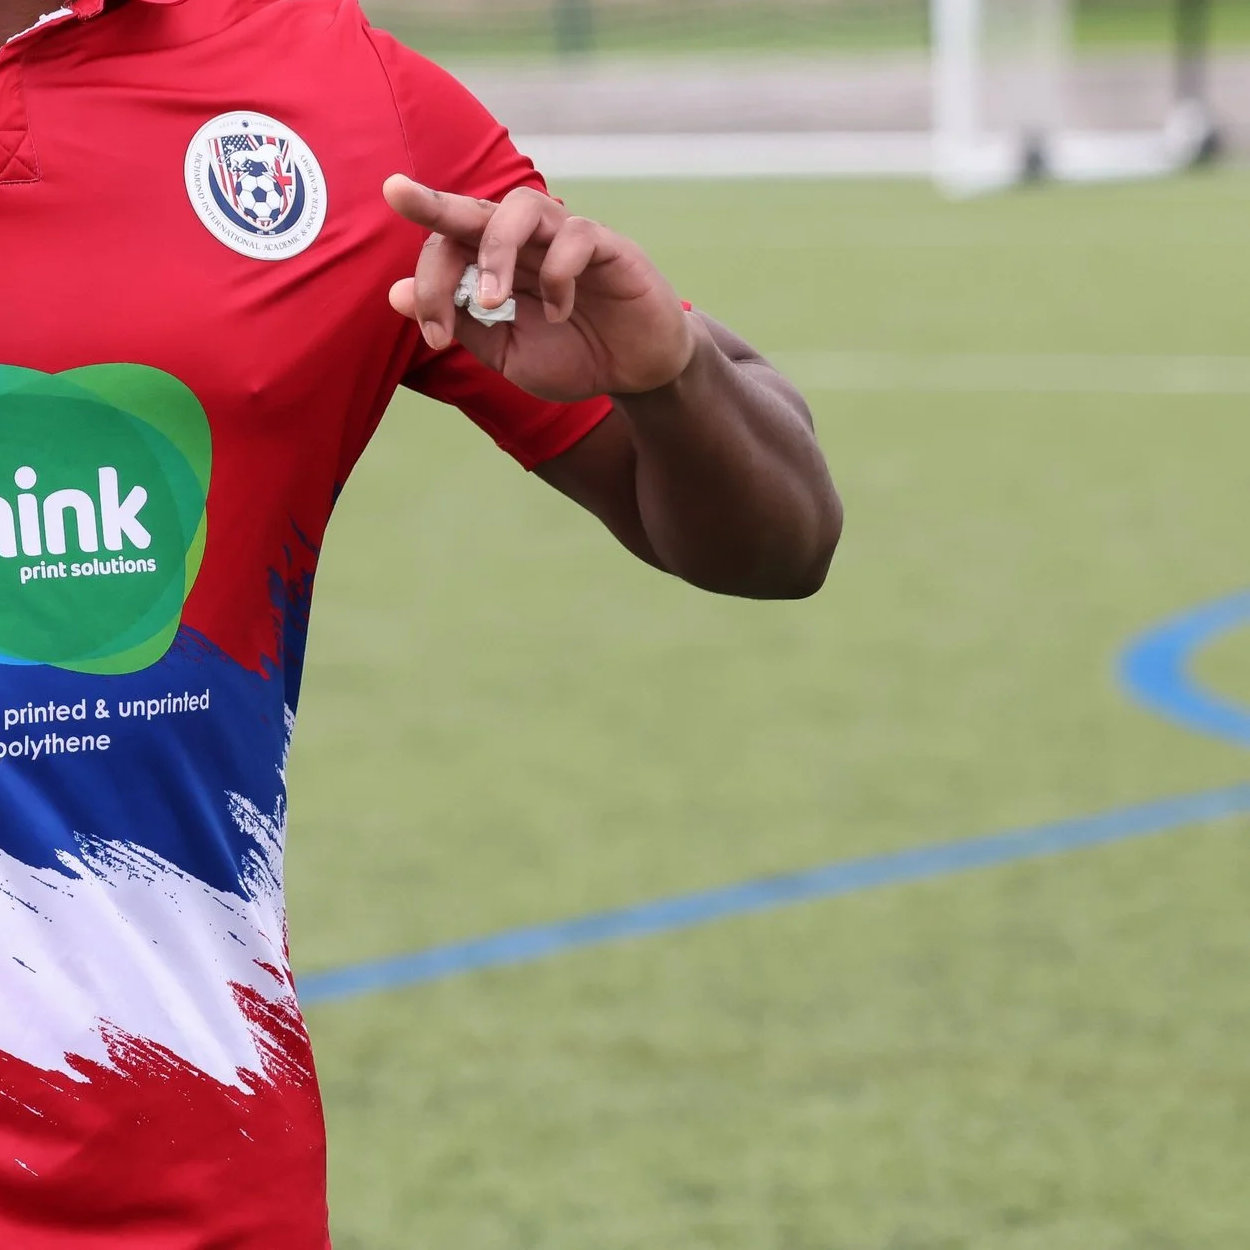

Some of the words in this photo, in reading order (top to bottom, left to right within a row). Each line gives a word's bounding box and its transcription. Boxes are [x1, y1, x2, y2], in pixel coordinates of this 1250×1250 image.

[193, 152, 205, 199] RICHMOND
[202, 201, 261, 249] INTERNATIONAL
[264, 235, 301, 251] ACADEMIC
[301, 229, 308, 237] &
[305, 198, 319, 229] SOCCER
[19, 560, 68, 584] print
[70, 555, 157, 578] solutions
[4, 698, 87, 731] printed
[94, 699, 111, 719] &
[118, 688, 210, 721] unprinted
